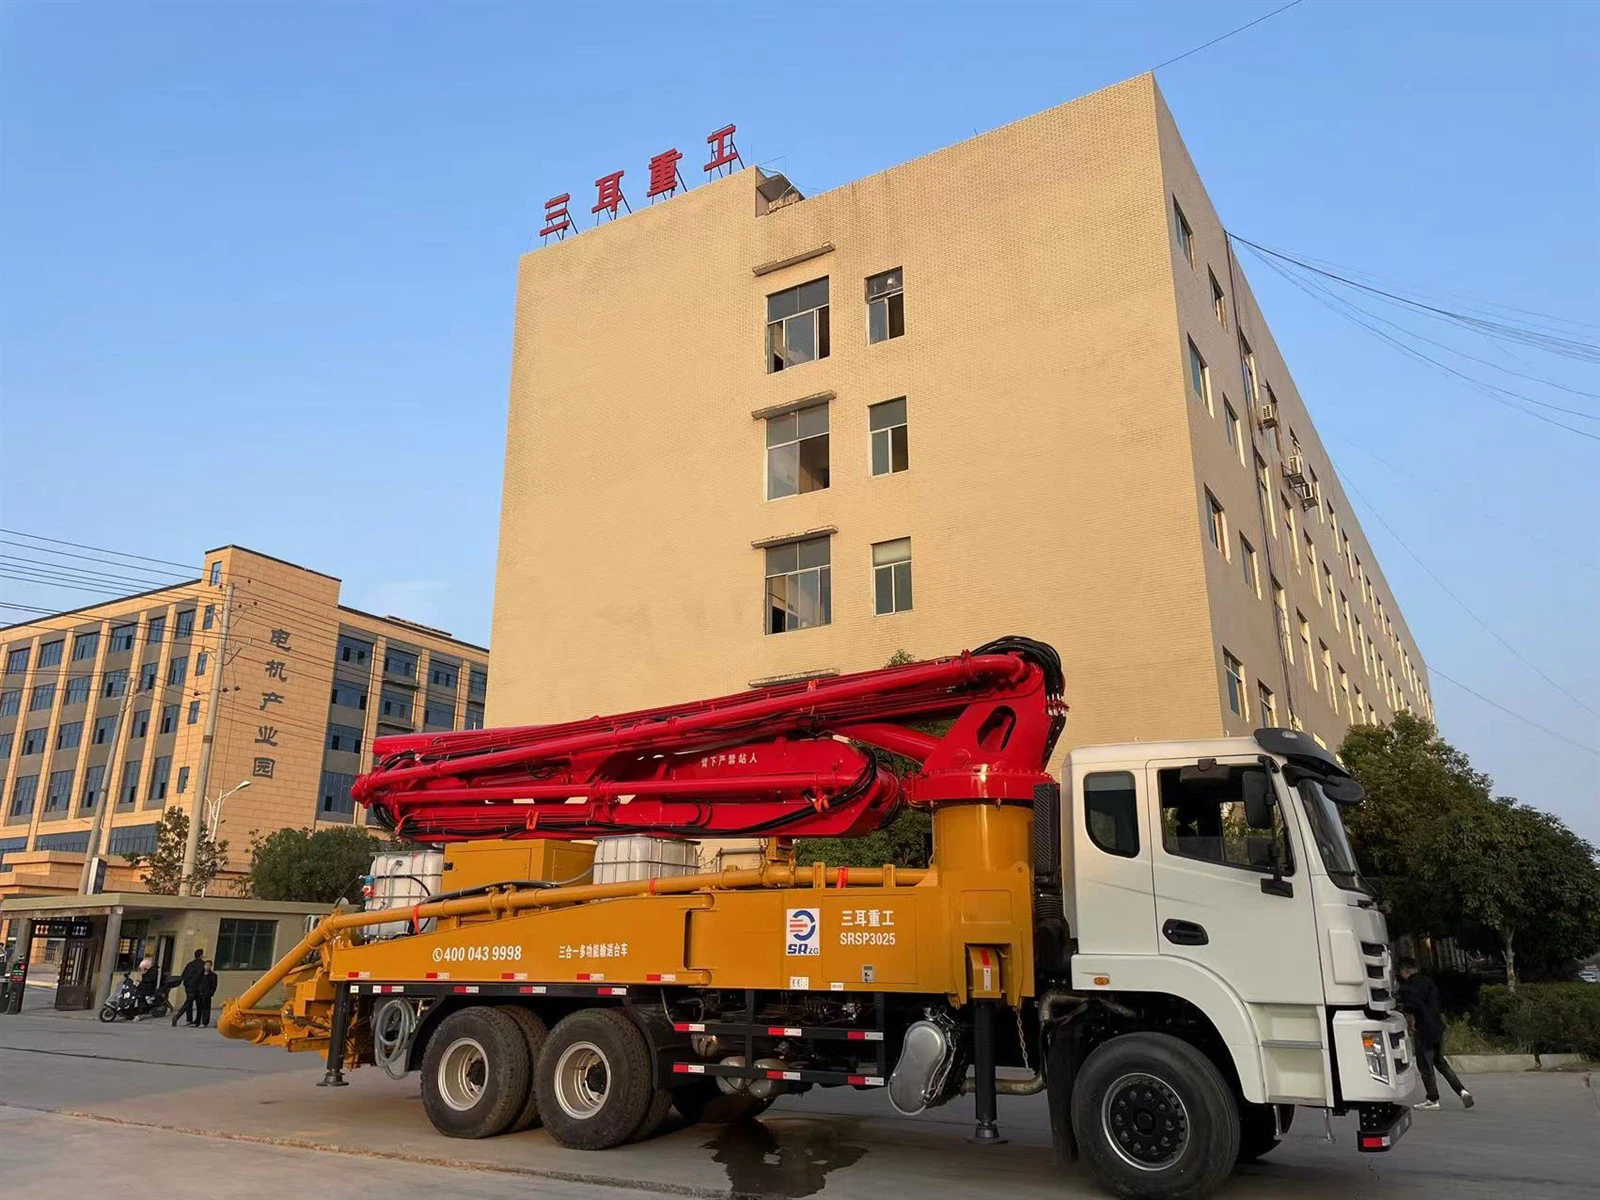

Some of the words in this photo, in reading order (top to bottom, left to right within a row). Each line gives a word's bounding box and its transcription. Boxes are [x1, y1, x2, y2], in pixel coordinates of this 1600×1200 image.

[539, 125, 738, 237] 三耳重工
[252, 628, 291, 779] 电机产业园
[841, 909, 895, 927] 三耳重工
[840, 932, 895, 945] SRSP3025
[444, 947, 465, 961] 400
[468, 946, 489, 961] 043
[492, 945, 522, 961] 9998
